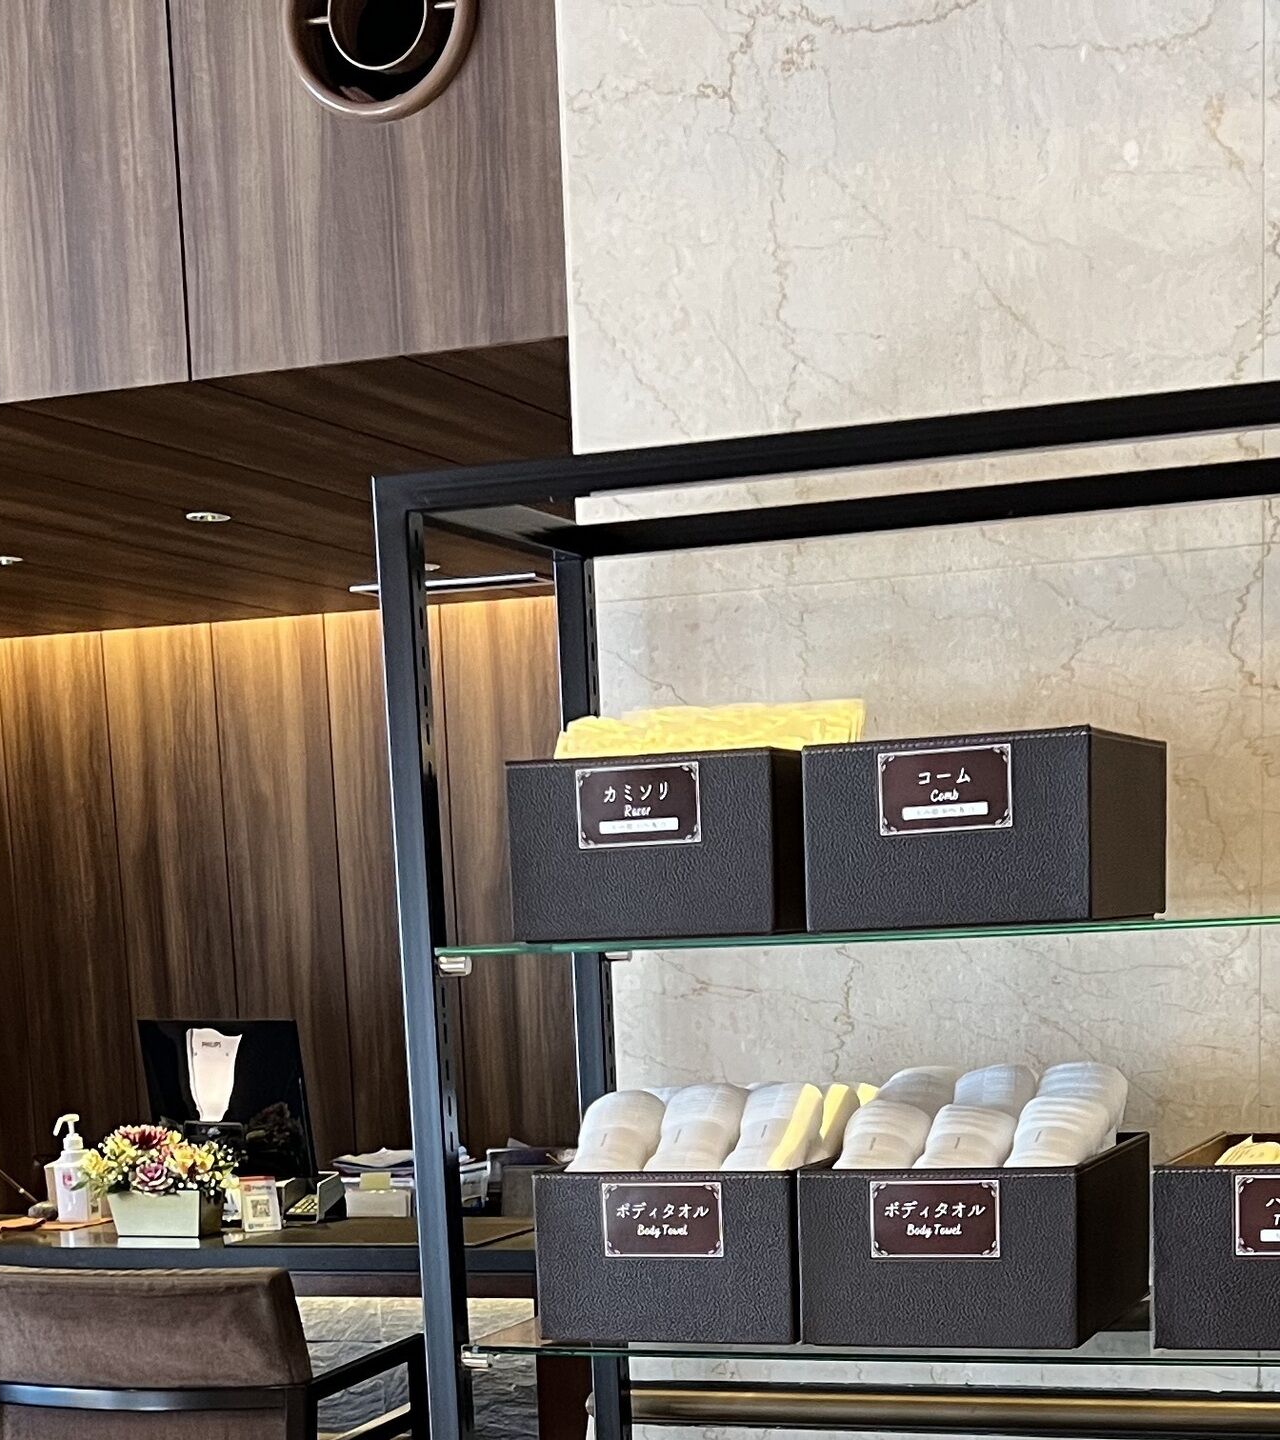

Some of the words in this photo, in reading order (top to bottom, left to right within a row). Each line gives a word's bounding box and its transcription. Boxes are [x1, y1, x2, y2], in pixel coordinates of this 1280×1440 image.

[918, 767, 971, 785] コーム
[603, 780, 668, 803] カミソリ
[930, 788, 959, 803] Comb
[637, 1224, 661, 1239] Body
[662, 1224, 688, 1236] Towel
[906, 1223, 932, 1239] Body
[933, 1223, 963, 1236] Towel
